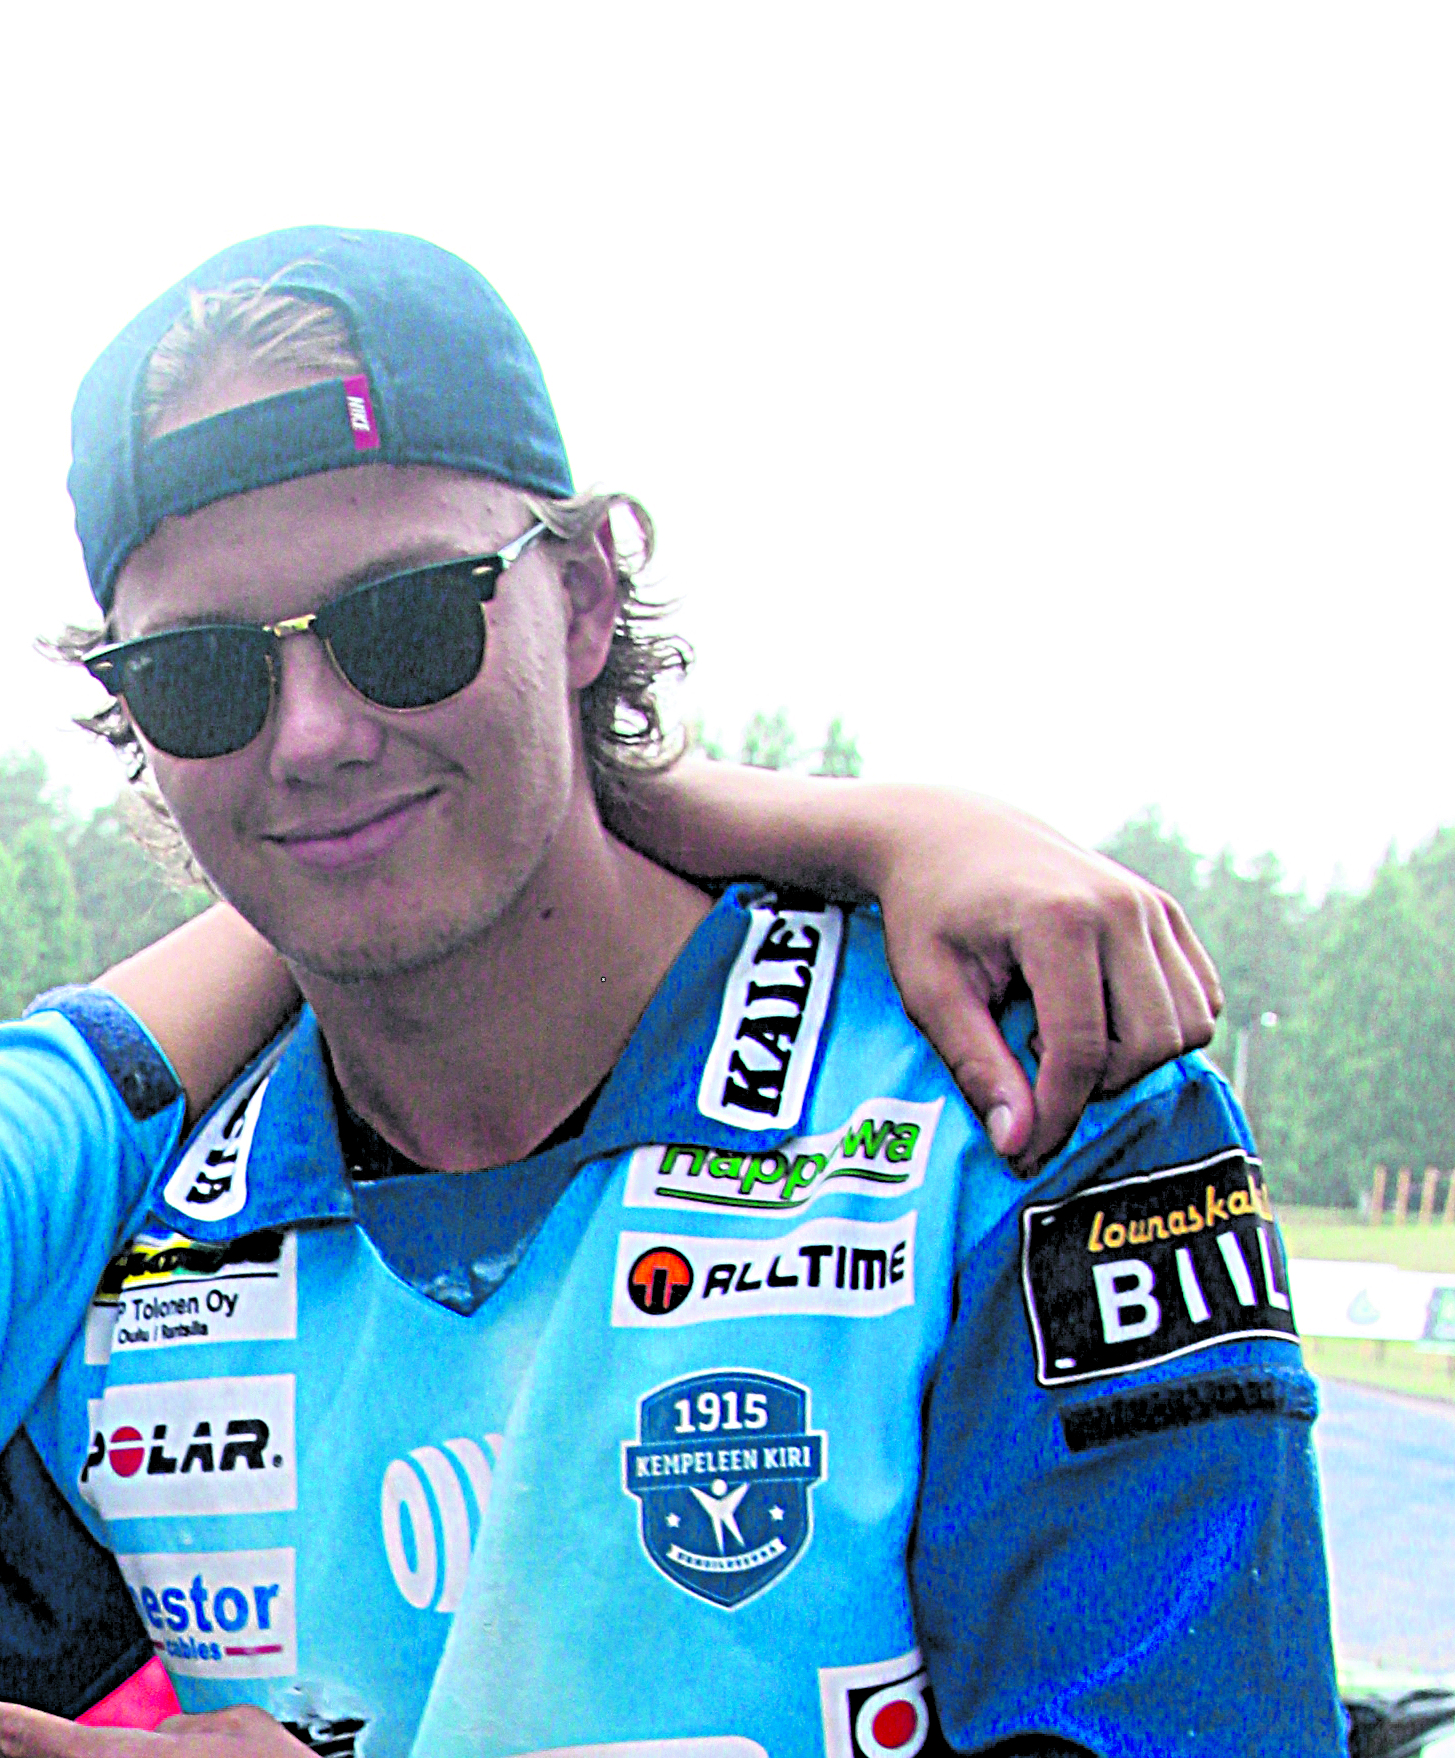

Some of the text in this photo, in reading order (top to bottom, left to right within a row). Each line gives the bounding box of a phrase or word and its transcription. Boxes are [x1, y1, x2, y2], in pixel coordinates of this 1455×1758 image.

[702, 1240, 908, 1300] ALLTIME
[206, 1289, 240, 1318] Oy
[673, 1391, 769, 1433] 1915
[635, 1445, 812, 1478] KEMPELEEN KIRI
[130, 1573, 280, 1633] estor
